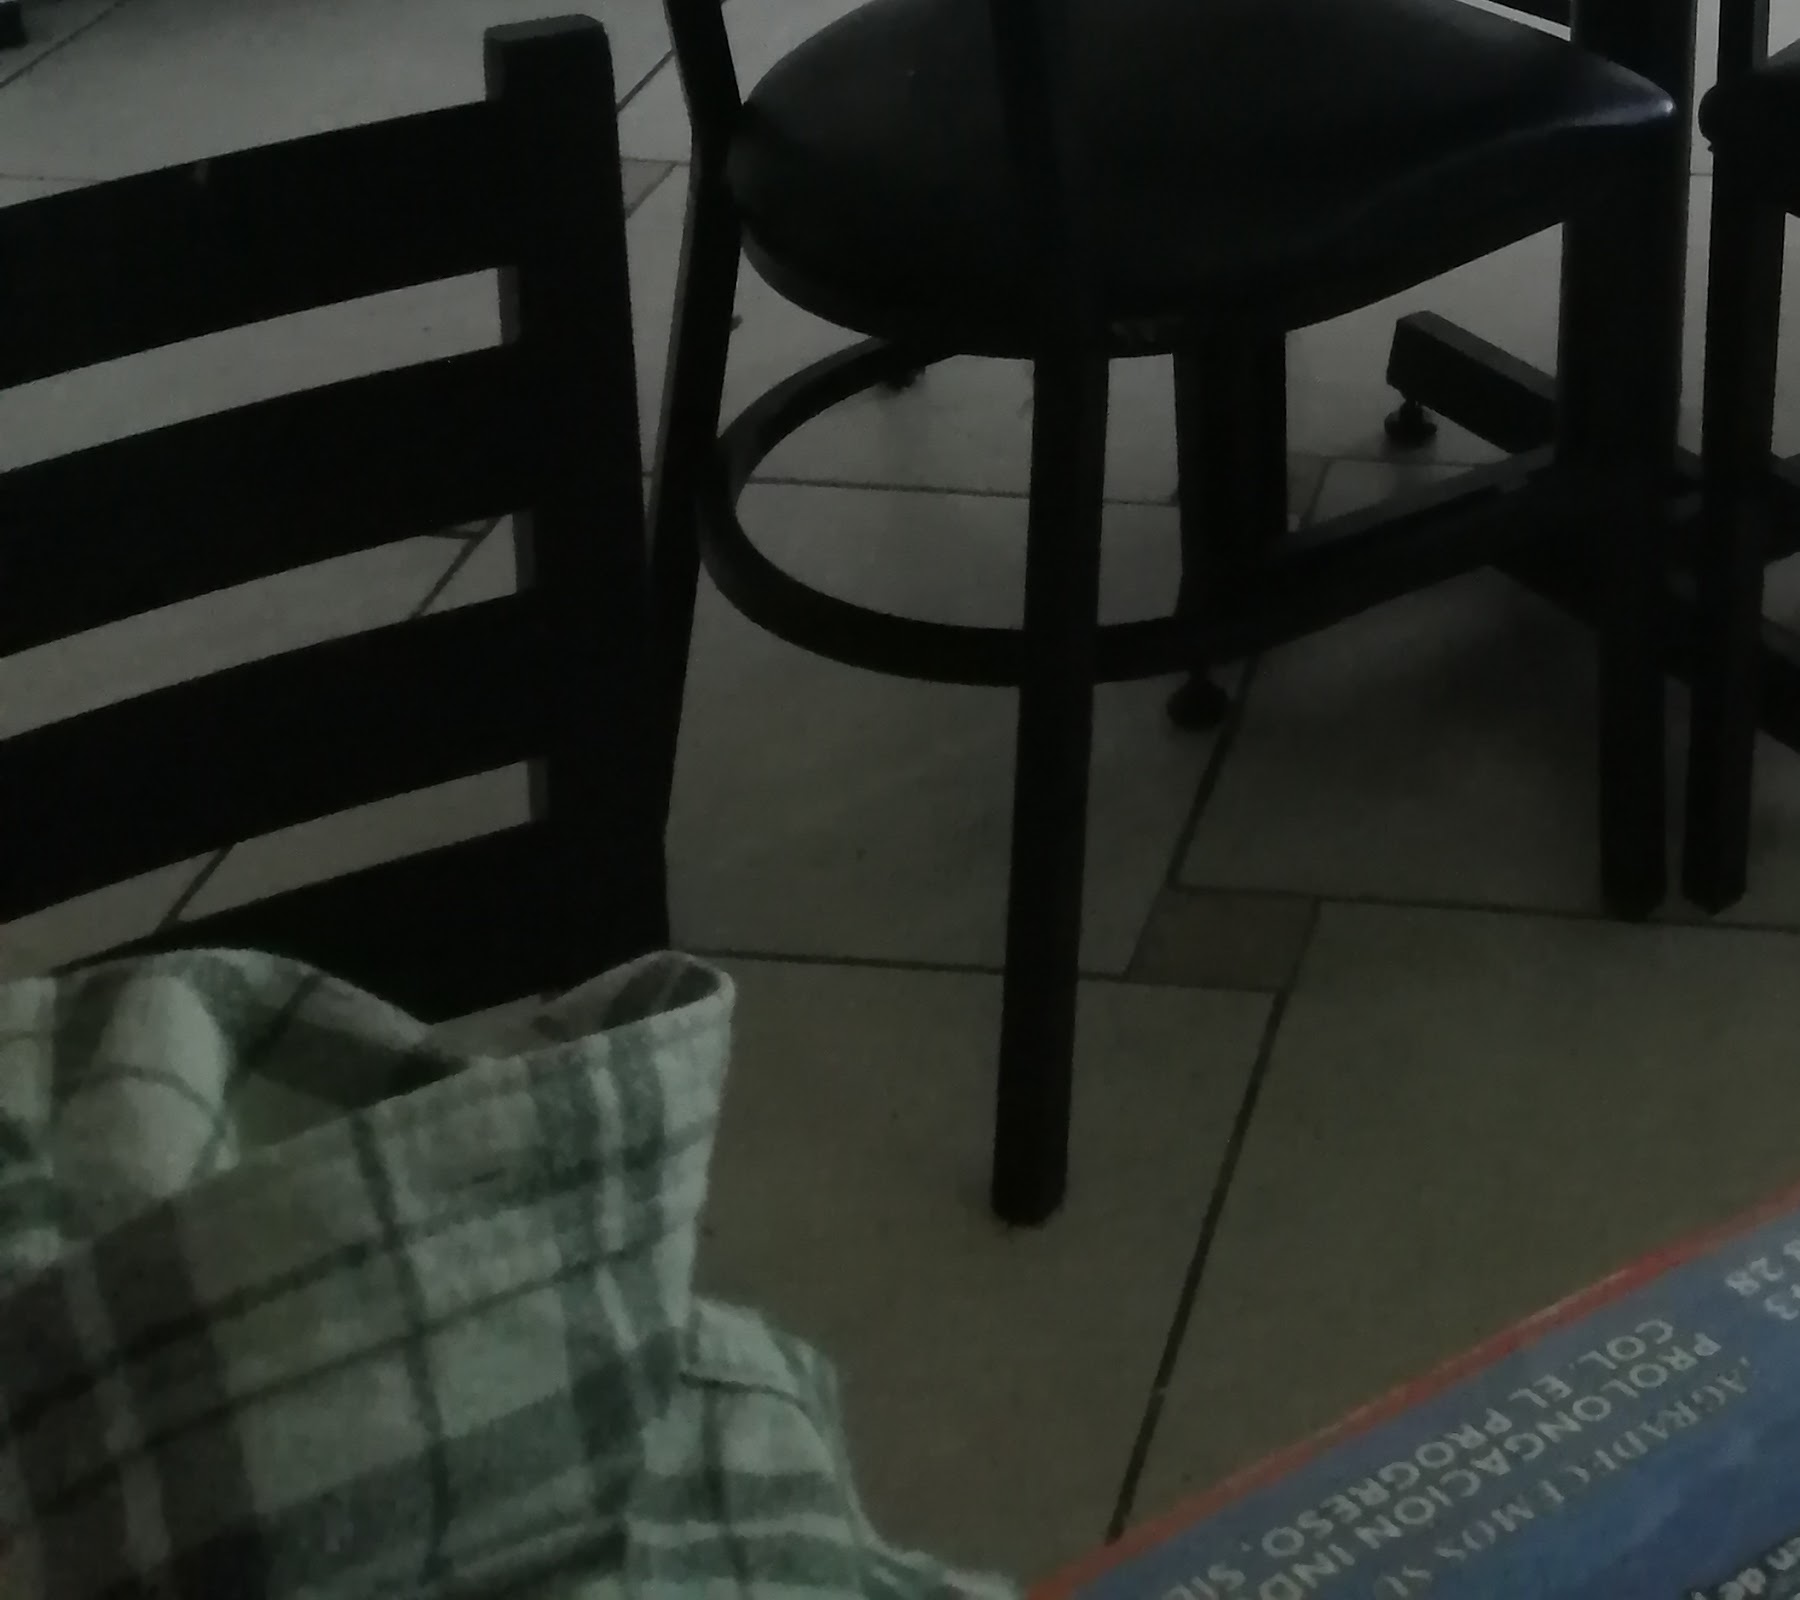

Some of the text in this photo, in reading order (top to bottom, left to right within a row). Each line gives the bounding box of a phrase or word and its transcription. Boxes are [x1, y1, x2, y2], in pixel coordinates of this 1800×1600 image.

[1725, 1256, 1784, 1296] 28
[1569, 1318, 1674, 1370] COL.
[1508, 1373, 1574, 1409] EL
